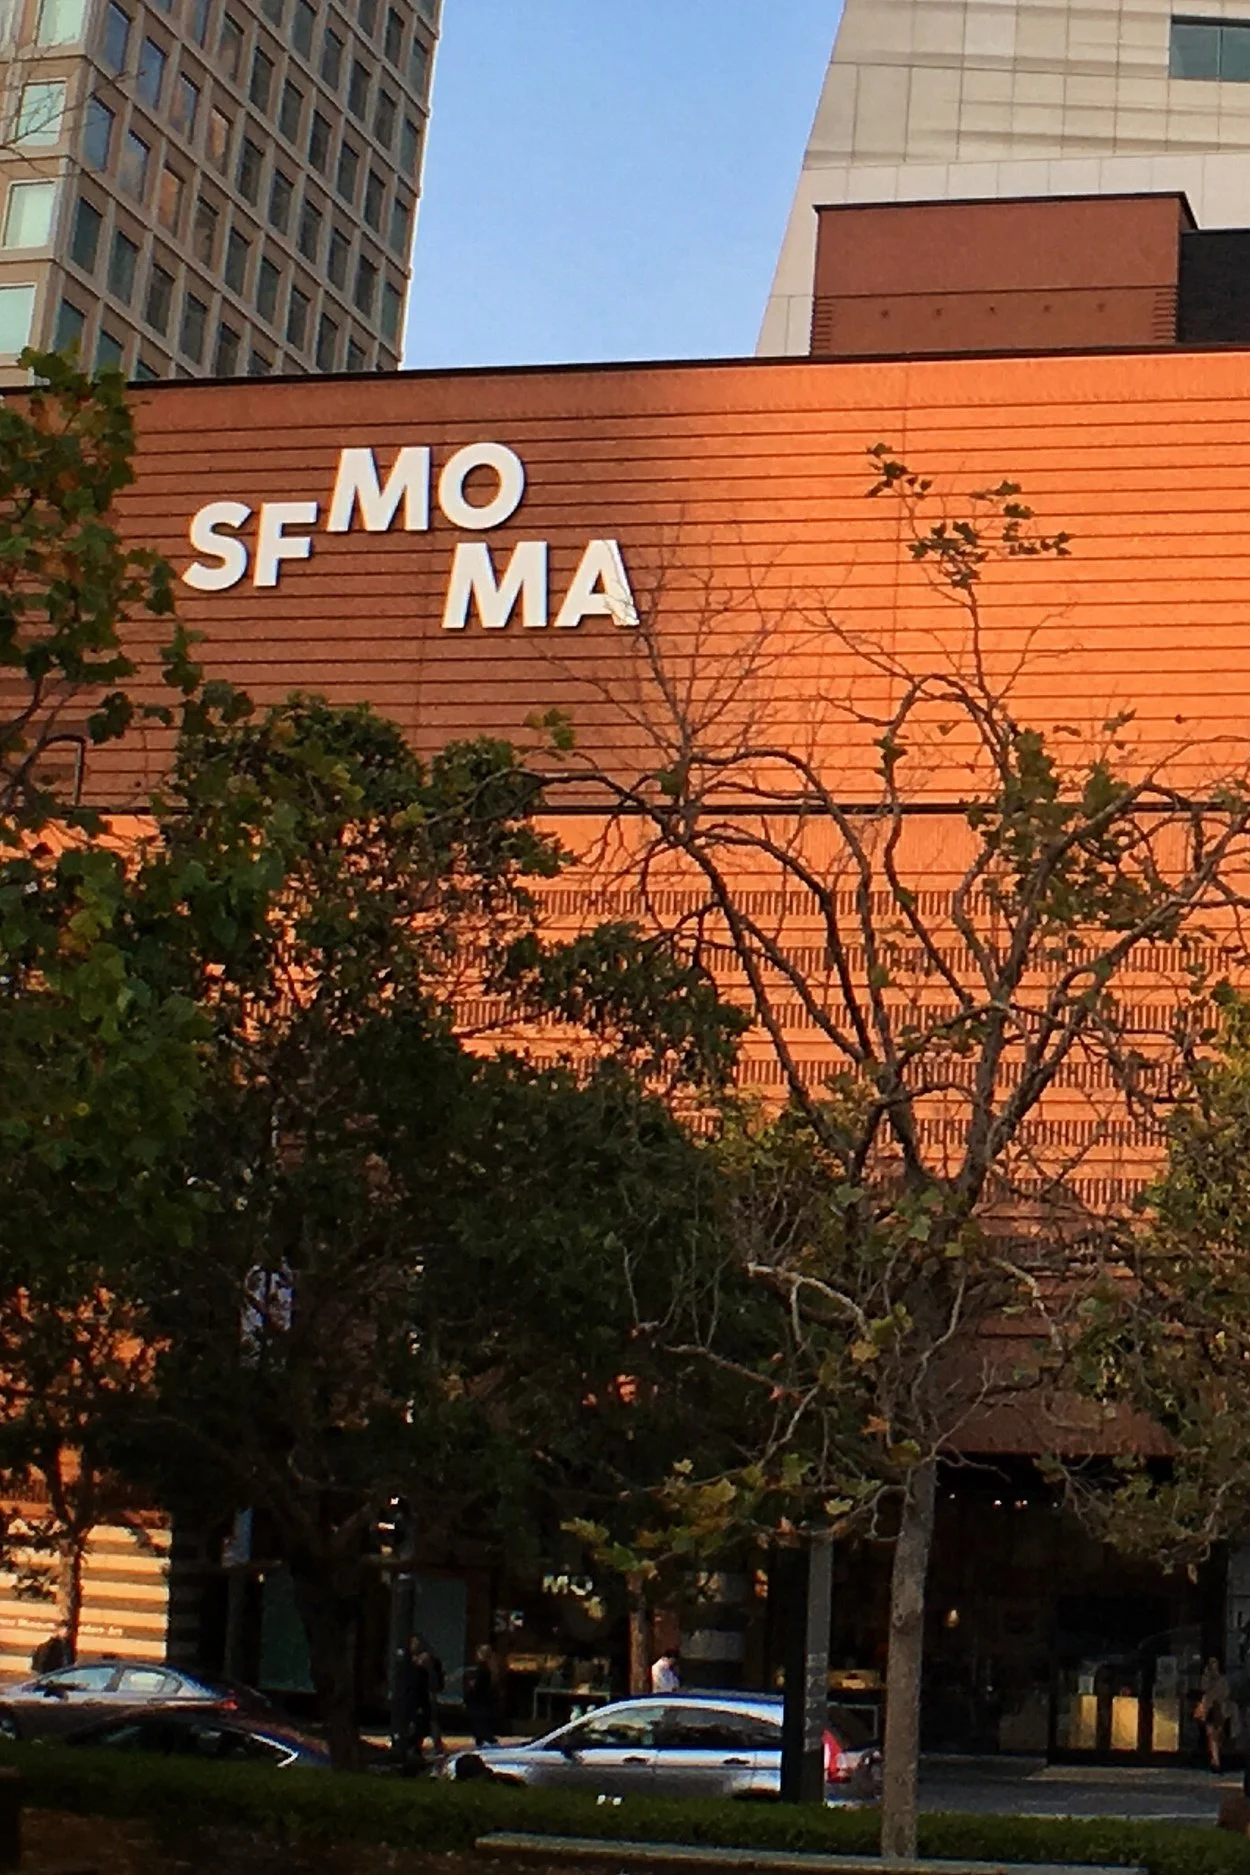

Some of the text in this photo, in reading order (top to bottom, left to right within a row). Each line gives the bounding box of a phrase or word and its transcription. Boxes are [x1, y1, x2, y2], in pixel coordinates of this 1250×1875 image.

[327, 442, 525, 532] MO
[183, 501, 318, 591] SF
[441, 539, 640, 629] MA
